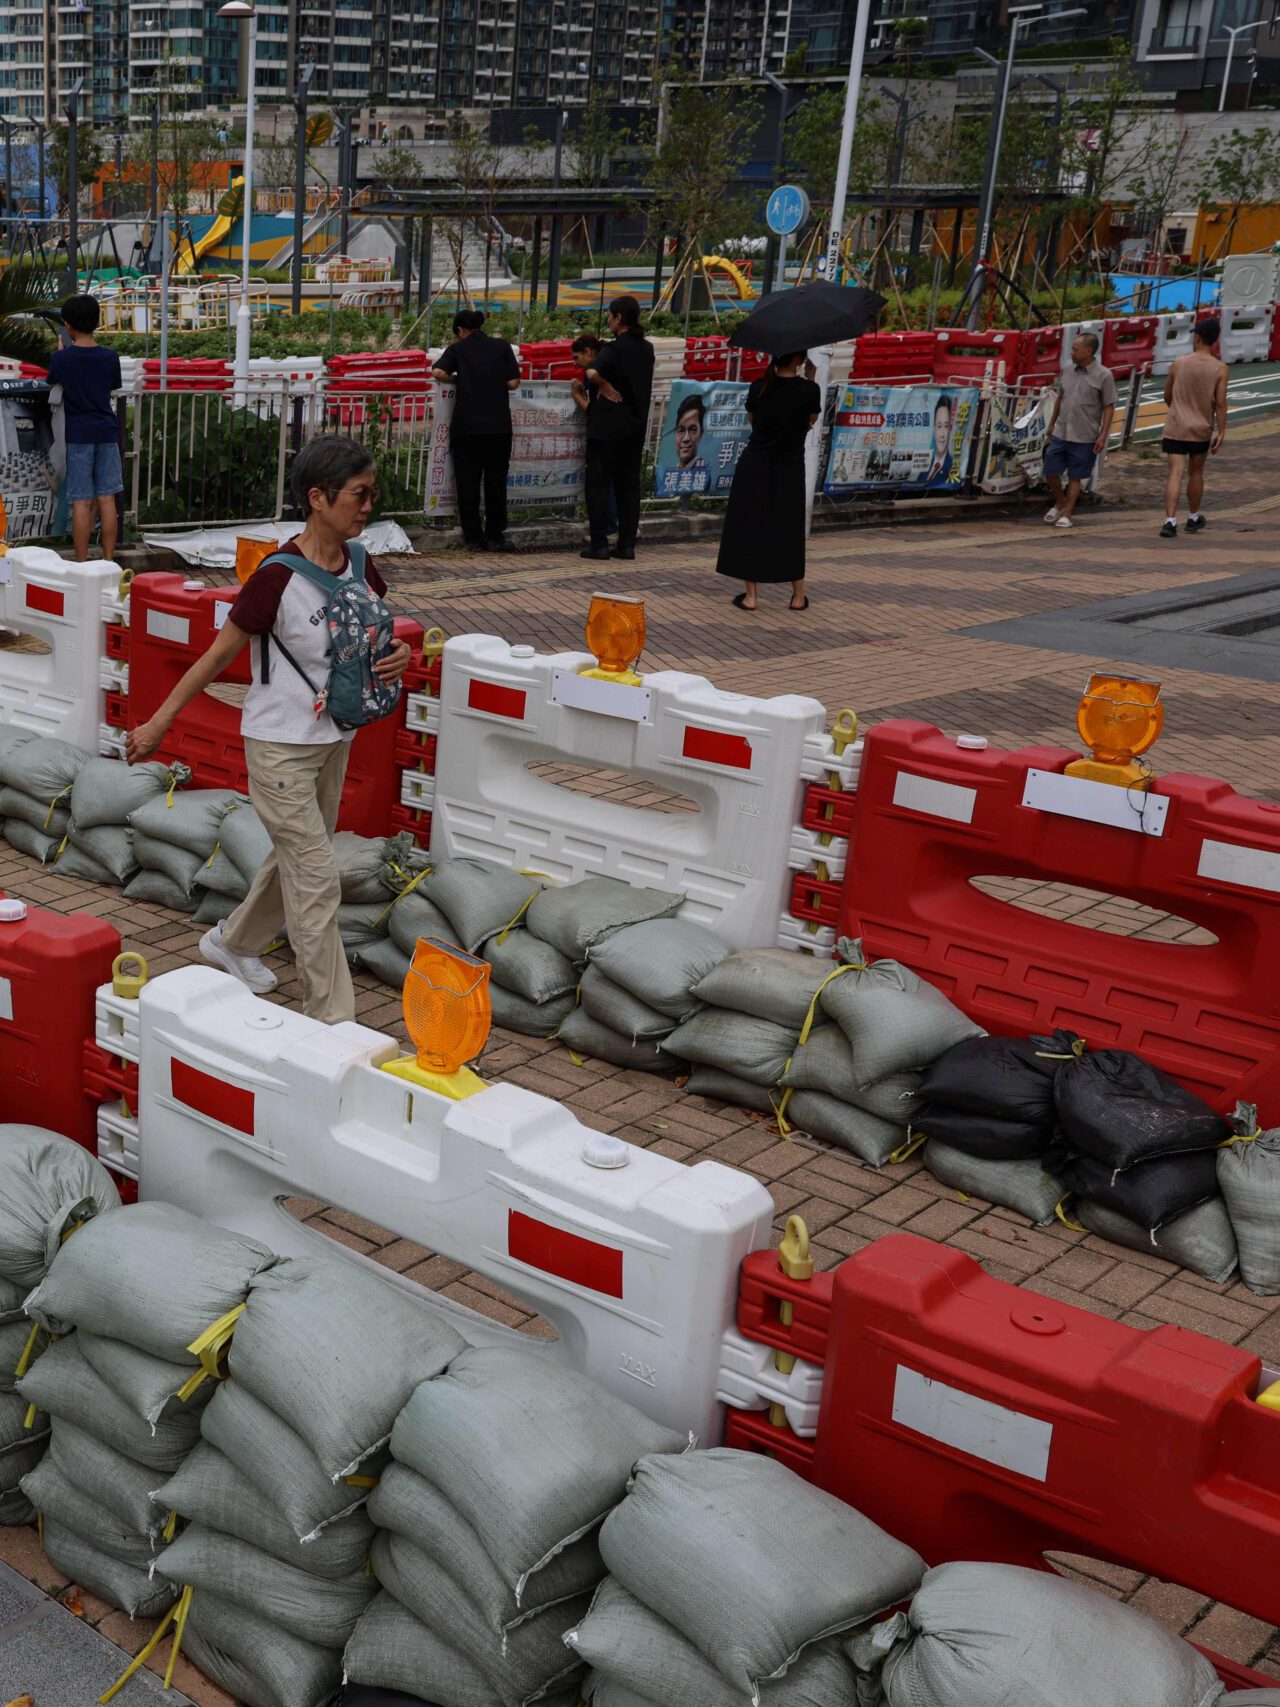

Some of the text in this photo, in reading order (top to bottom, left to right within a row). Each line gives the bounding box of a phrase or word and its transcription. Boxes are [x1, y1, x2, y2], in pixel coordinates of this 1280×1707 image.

[828, 231, 840, 280] DE 2277
[664, 470, 707, 492] 張美雄
[618, 1352, 656, 1386] MAX
